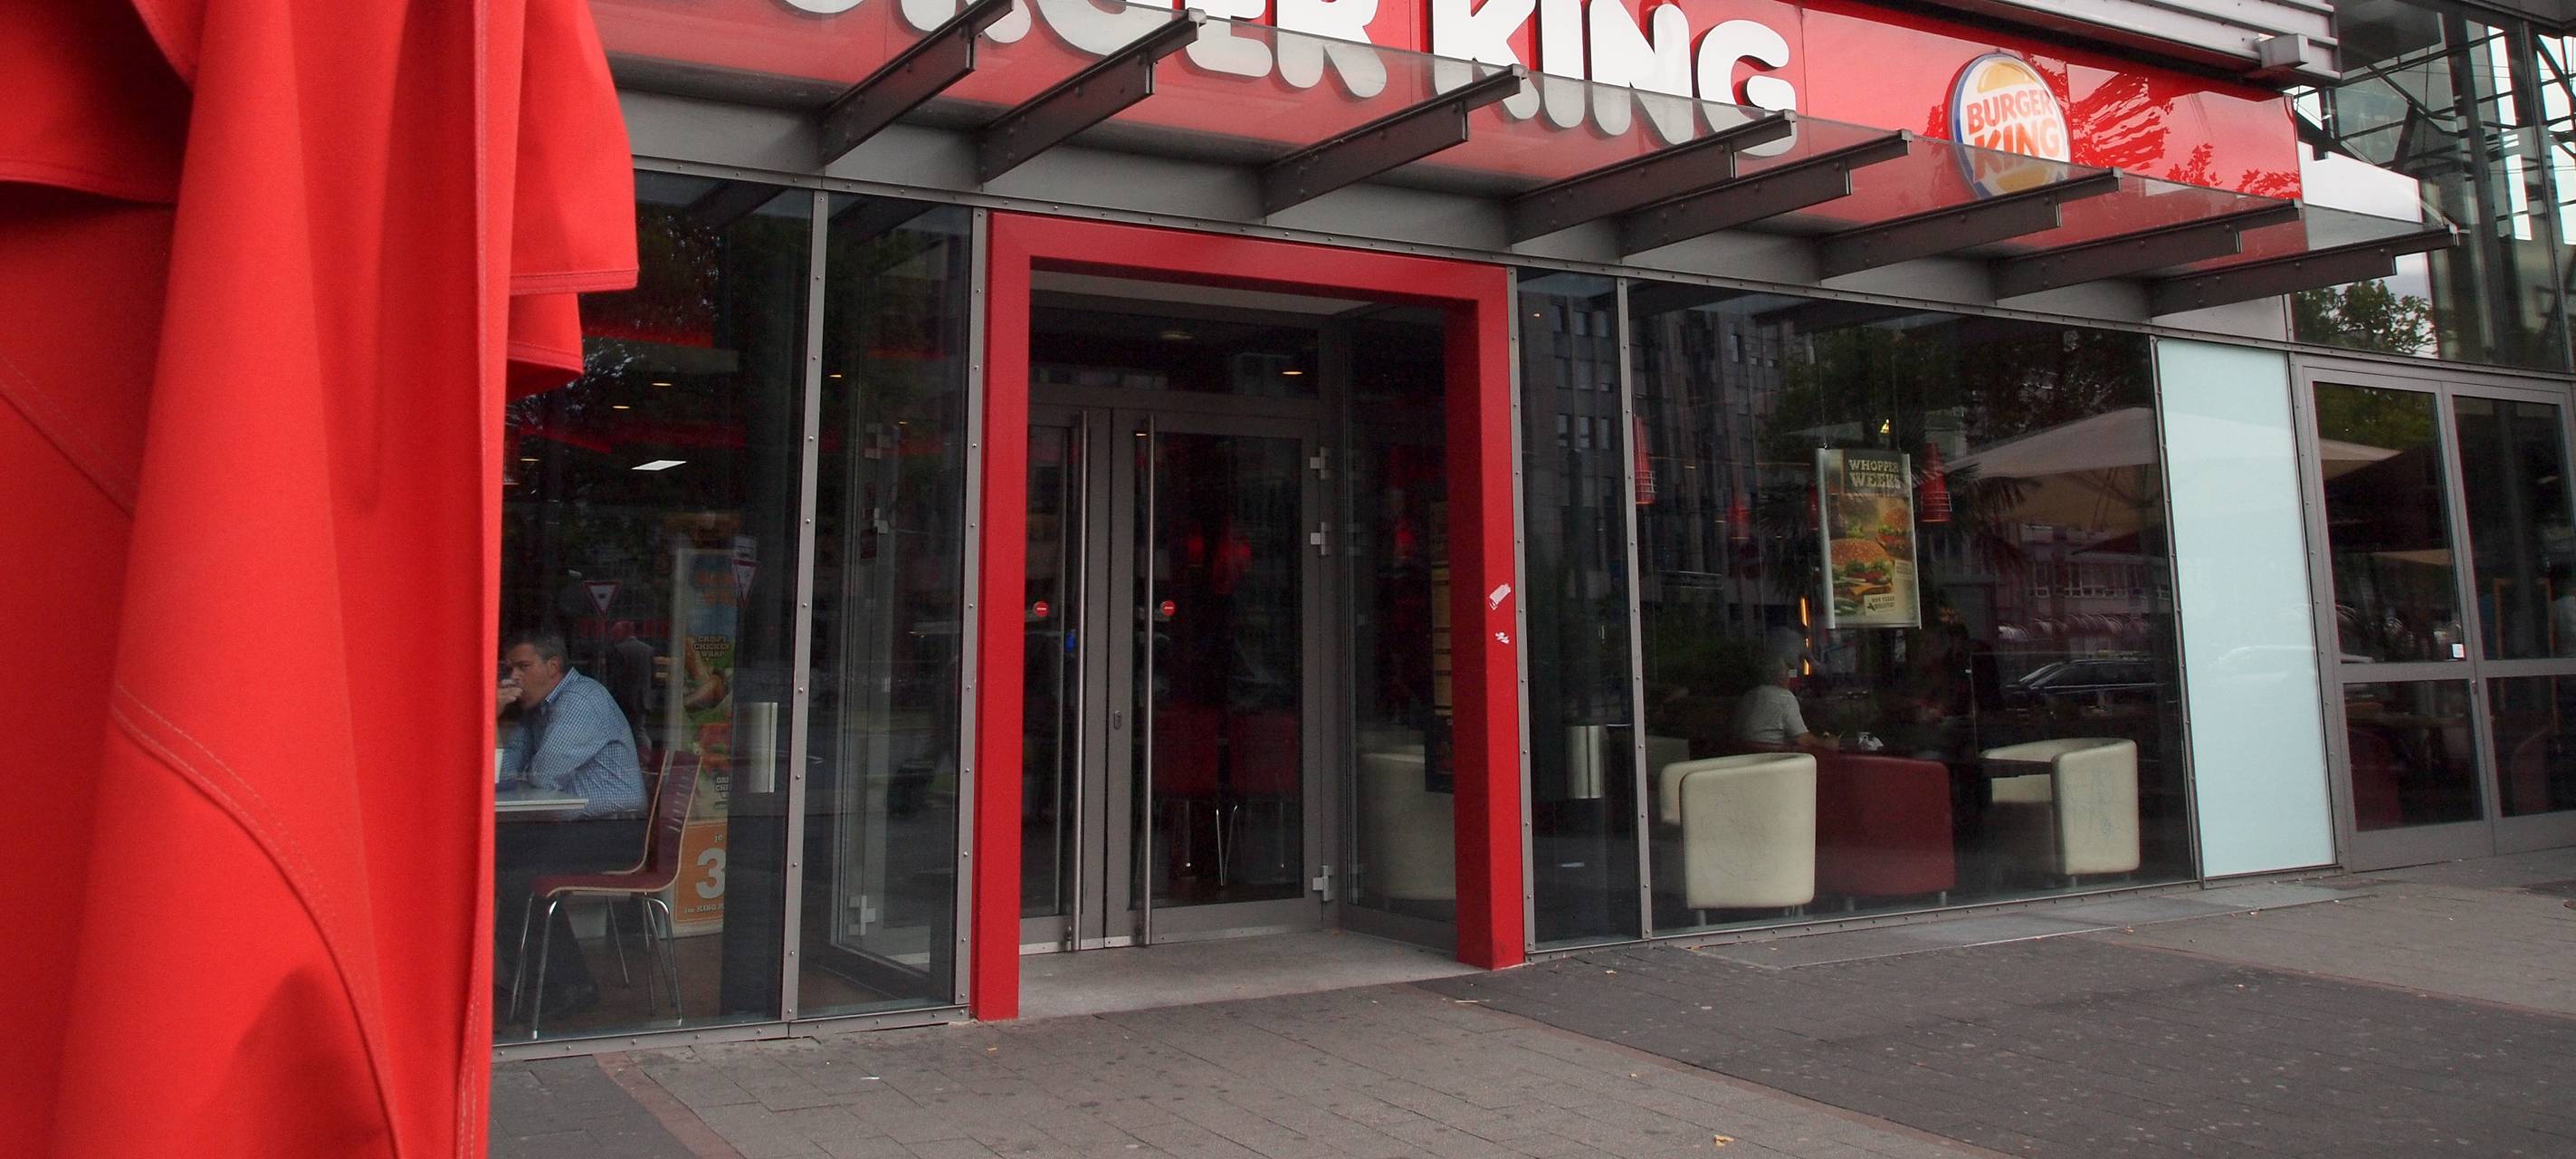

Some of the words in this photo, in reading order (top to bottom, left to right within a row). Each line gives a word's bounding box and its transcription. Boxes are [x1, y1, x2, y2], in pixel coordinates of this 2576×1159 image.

[1431, 0, 1798, 158] KING
[1967, 89, 2054, 135] BURGER
[1973, 118, 2060, 181] KING
[1848, 459, 1899, 473] WHOPPER
